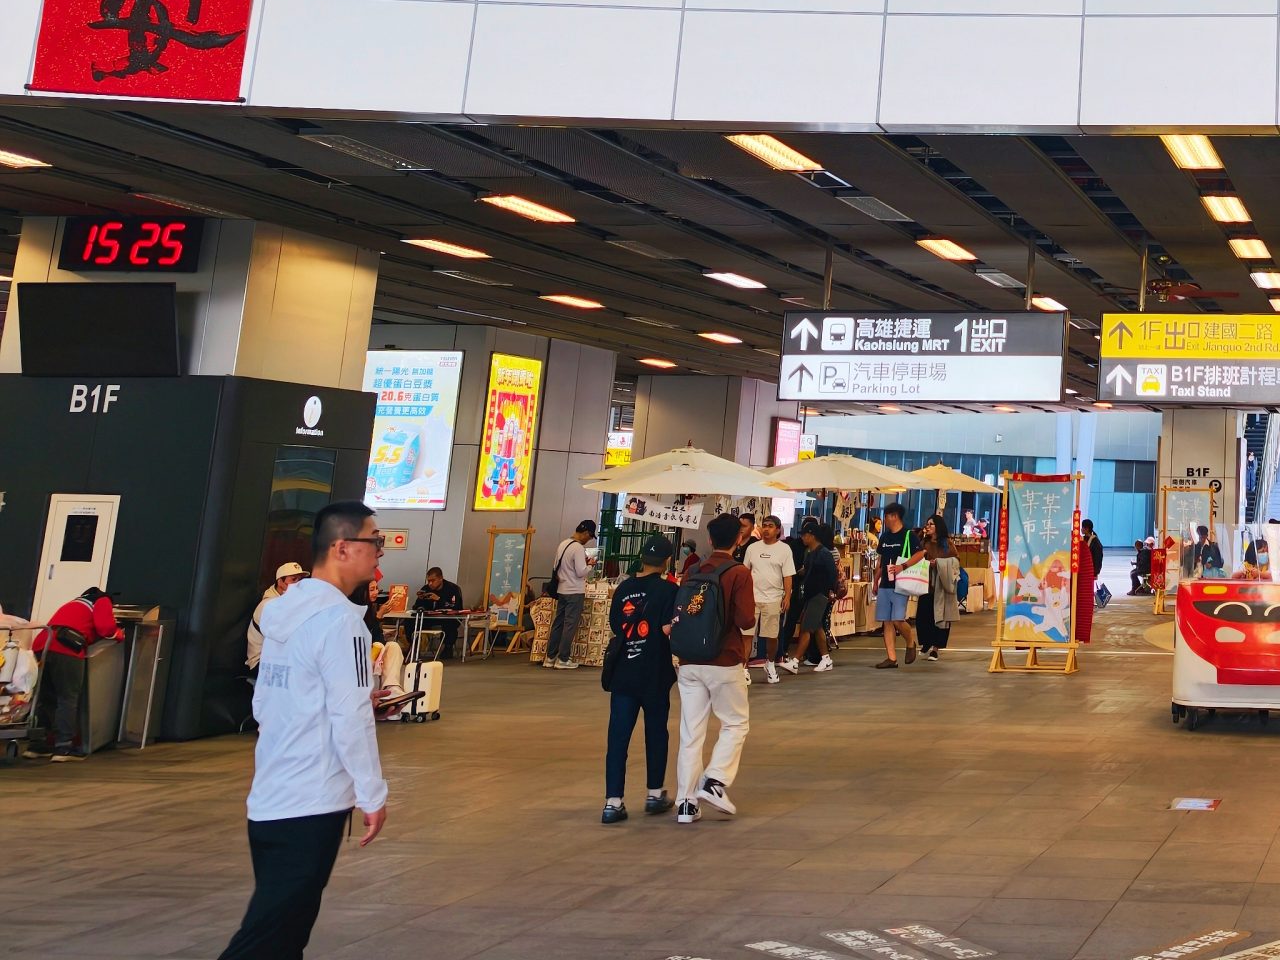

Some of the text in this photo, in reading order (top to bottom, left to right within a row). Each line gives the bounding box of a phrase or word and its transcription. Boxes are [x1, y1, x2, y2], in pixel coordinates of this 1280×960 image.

[856, 318, 932, 339] 高雄捷運
[971, 319, 1007, 338] 出口
[855, 339, 950, 353] Kaohsiung MRT
[971, 339, 1005, 352] EXIT
[1203, 342, 1242, 353] Jianguo
[1244, 342, 1263, 352] 2nd
[853, 362, 947, 381] 汽車停車場
[852, 383, 920, 395] Parking Lot
[1171, 386, 1231, 398] Taxi Stand
[69, 384, 121, 413] B1F
[1187, 468, 1210, 477] B1F
